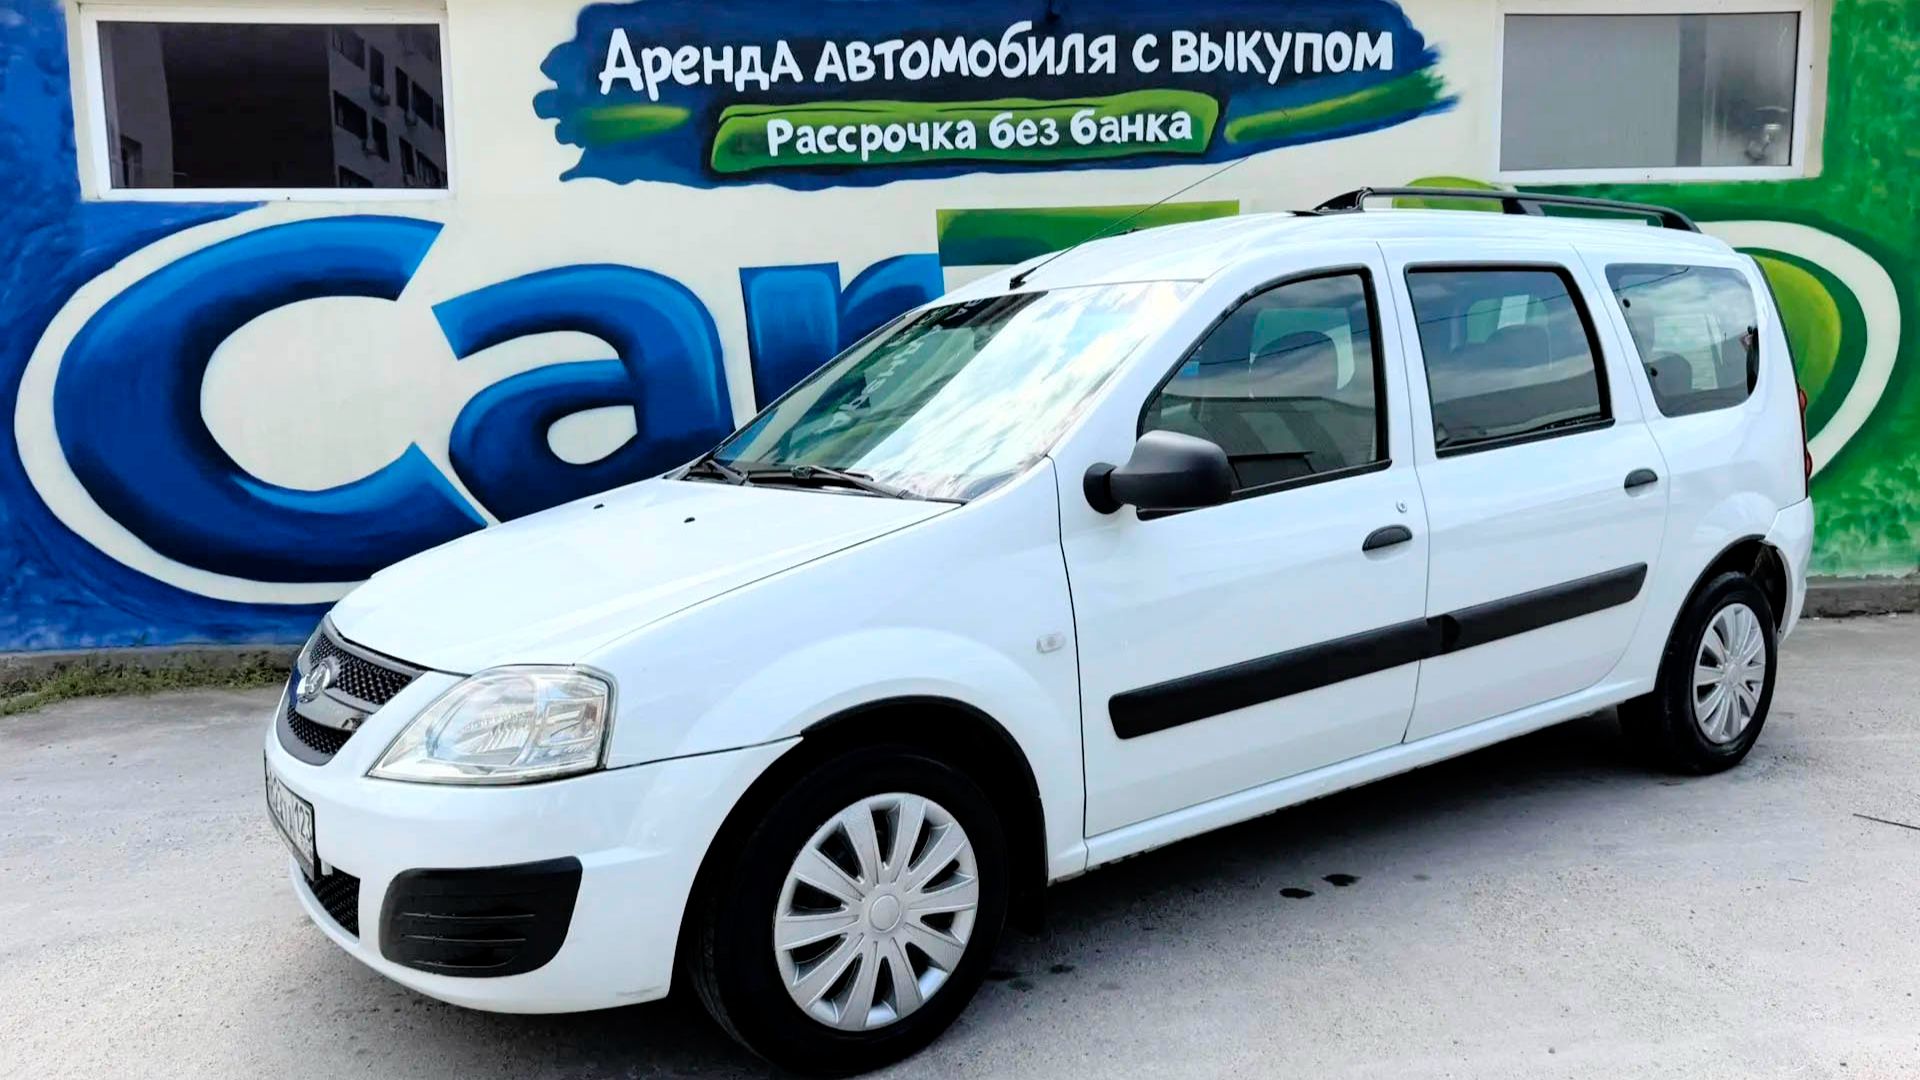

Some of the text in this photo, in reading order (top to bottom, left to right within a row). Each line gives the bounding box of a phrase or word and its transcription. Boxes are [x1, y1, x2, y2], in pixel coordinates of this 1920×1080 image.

[1133, 34, 1159, 72] с
[1172, 31, 1392, 84] выкупом
[768, 109, 1191, 160] Рассрочка без банка
